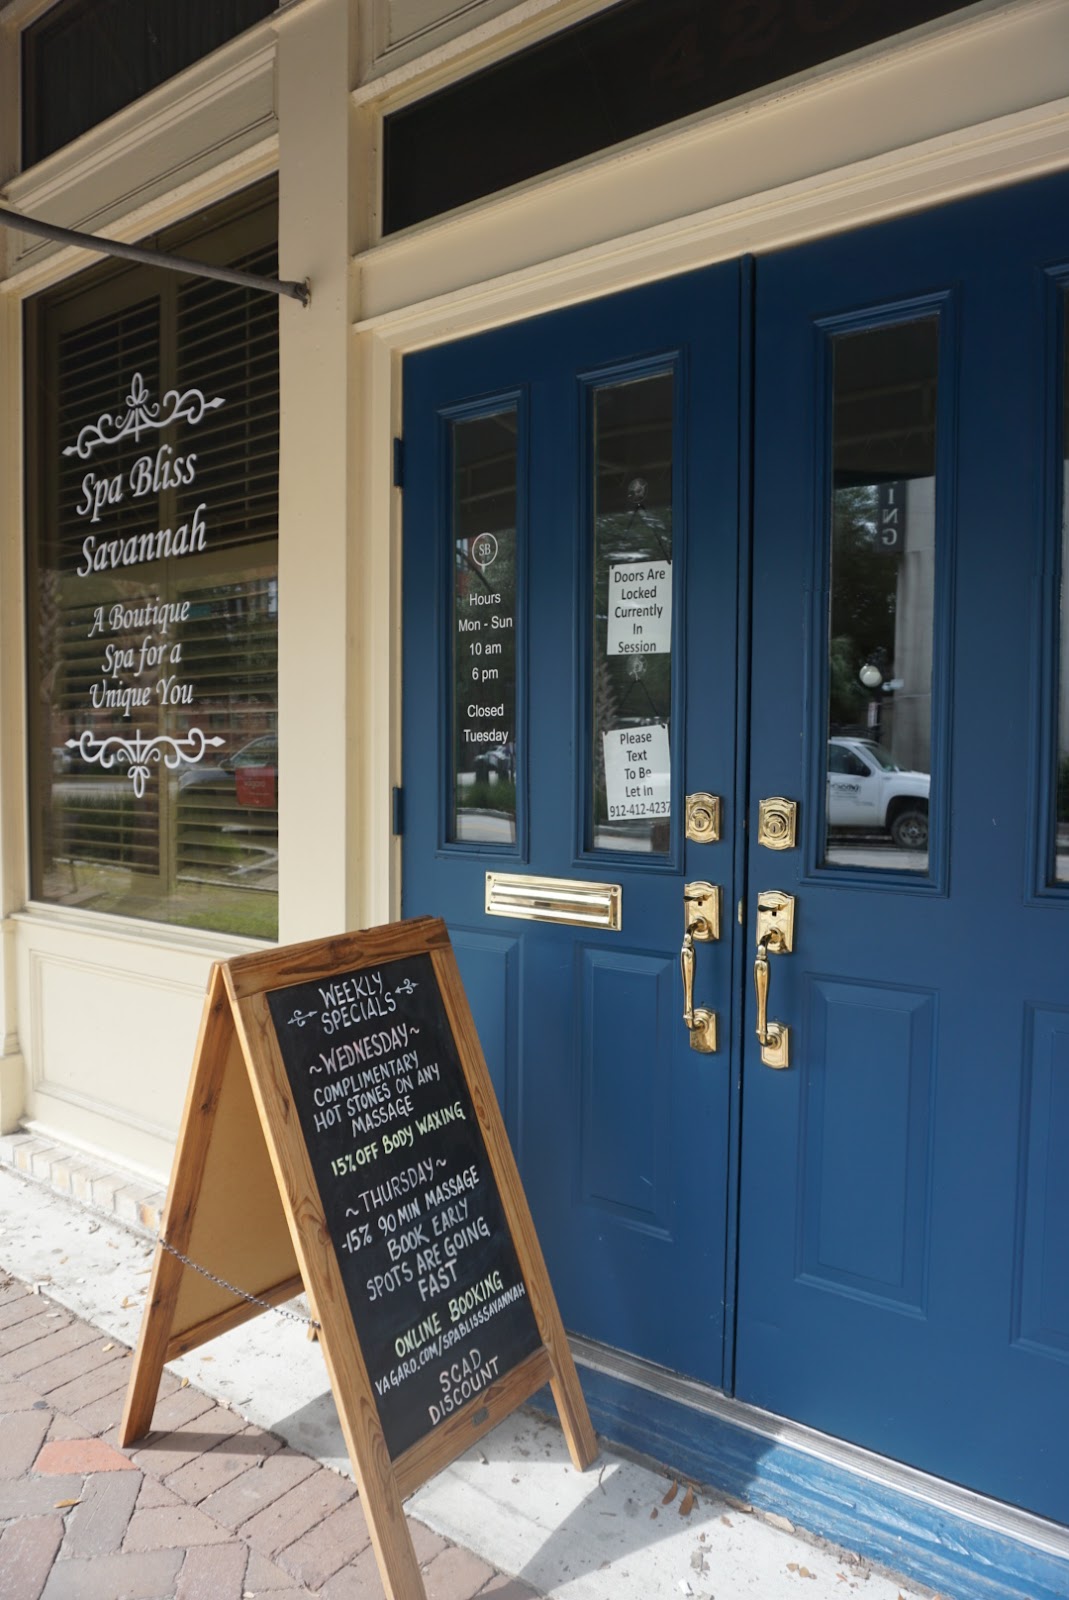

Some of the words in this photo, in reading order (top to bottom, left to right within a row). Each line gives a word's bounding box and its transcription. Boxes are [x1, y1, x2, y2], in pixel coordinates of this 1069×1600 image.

[76, 472, 123, 523] Spa
[130, 444, 197, 497] Bliss
[76, 503, 207, 577] Savannah
[479, 543, 491, 556] SB
[614, 571, 645, 583] Doors
[647, 568, 666, 581] Are
[621, 585, 657, 600] Locked
[88, 606, 104, 637] A
[108, 596, 190, 634] Boutique
[469, 593, 502, 607] Hours
[614, 603, 664, 619] Currently
[458, 619, 481, 632] Mon
[491, 615, 513, 629] Sun
[633, 623, 643, 635] In
[101, 643, 134, 678] Spa
[133, 636, 164, 677] for
[169, 642, 181, 664] a
[469, 642, 482, 656] 10
[485, 643, 502, 655] am
[618, 640, 657, 653] Session
[472, 667, 479, 680] 6
[481, 668, 498, 683] pm
[89, 679, 151, 717] Unique
[156, 675, 193, 705] You
[467, 703, 504, 718] Closed
[463, 728, 509, 745] Tuesday
[620, 732, 652, 745] Please
[626, 749, 648, 762] Text
[624, 768, 636, 780] To
[639, 767, 652, 779] Be
[625, 786, 641, 798] Let
[609, 801, 671, 817] 912-412-4237
[318, 971, 383, 1009] WEEKLY
[321, 991, 397, 1035] SPECIALS
[313, 1050, 420, 1107] COMPLIMENTARY
[313, 1104, 343, 1133] HOT
[346, 1083, 391, 1117] STONES
[396, 1075, 414, 1095] ON
[417, 1062, 441, 1086] ANY
[352, 1095, 414, 1138] MASSAGE
[382, 1125, 414, 1155] BODY
[415, 1101, 466, 1135] WAXING
[341, 1223, 372, 1254] -15%
[378, 1213, 397, 1237] 90
[397, 1197, 421, 1226] MIN
[424, 1165, 480, 1211] MASSAGE
[387, 1223, 430, 1261] BOOK
[432, 1197, 468, 1237] EARLY
[366, 1261, 413, 1301] SPOTS
[416, 1243, 442, 1275] ARE
[443, 1216, 491, 1258] GOING
[418, 1259, 457, 1302] FAST
[394, 1312, 442, 1358] ONLINE
[448, 1270, 504, 1322] BOOKING
[439, 1348, 482, 1393] SCAD
[428, 1355, 499, 1426] DISCOUNT
